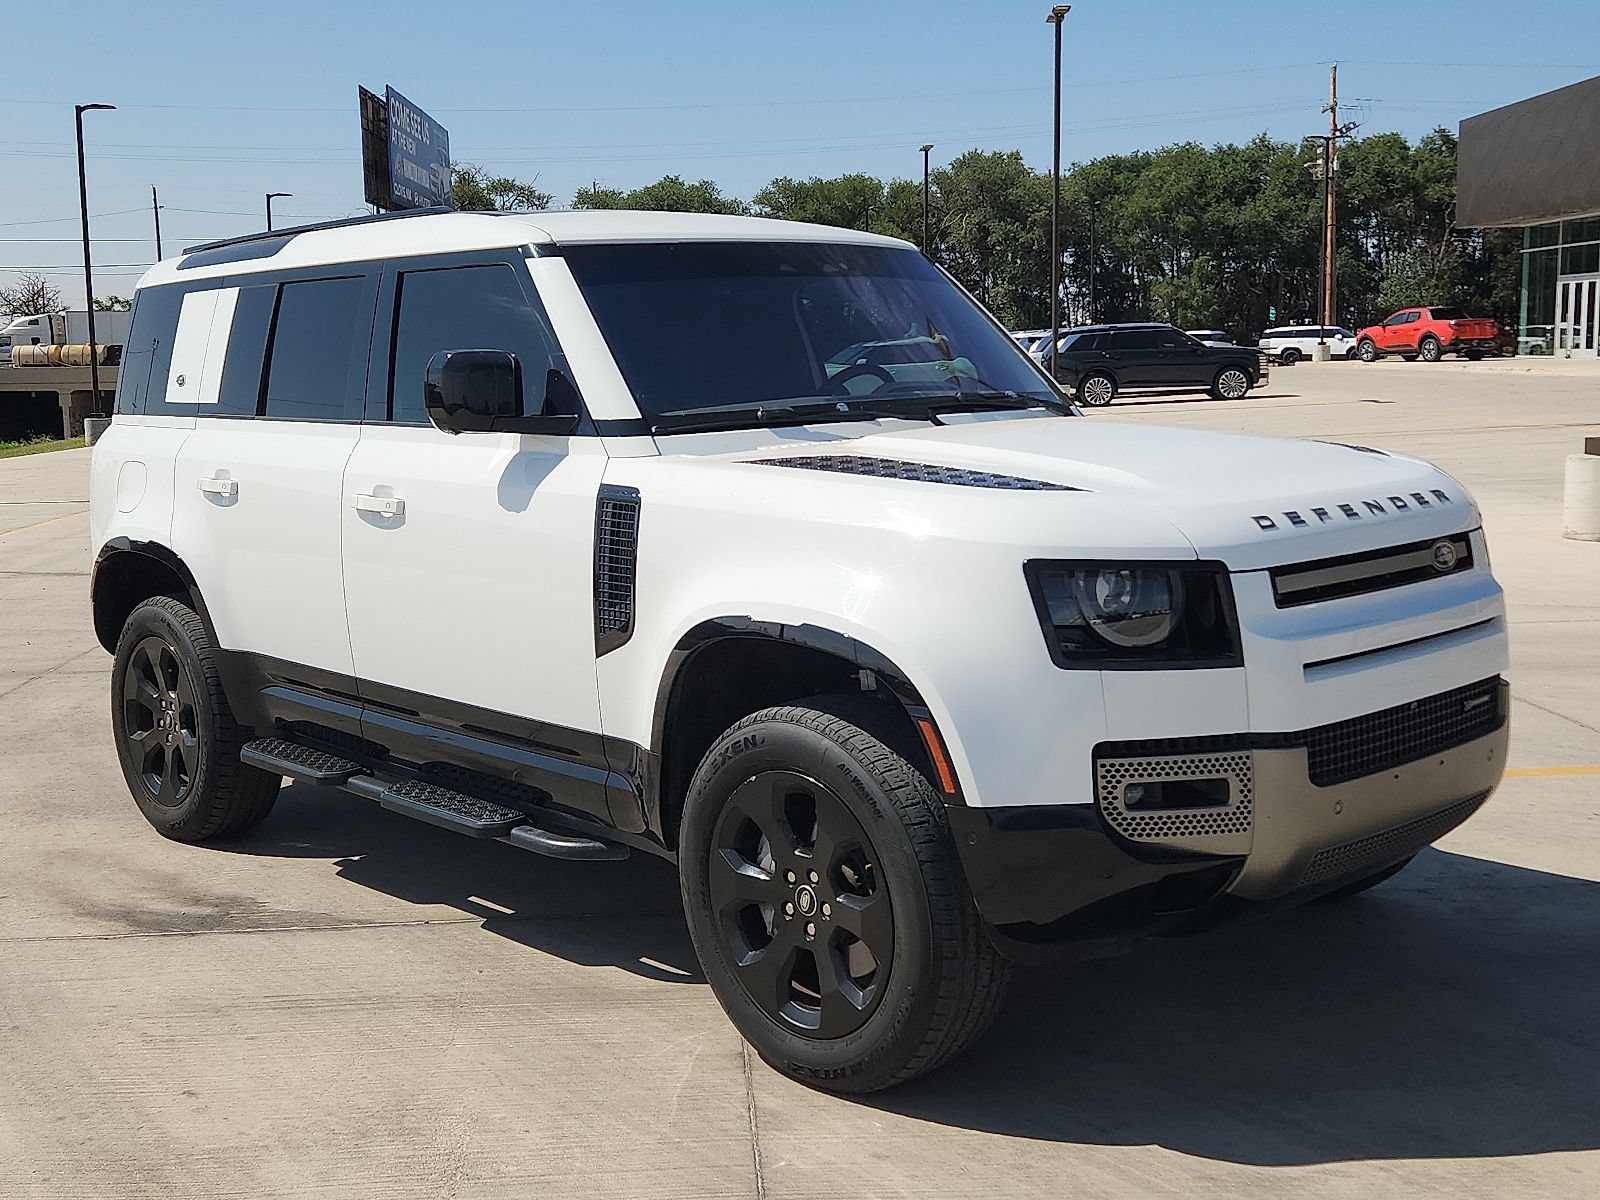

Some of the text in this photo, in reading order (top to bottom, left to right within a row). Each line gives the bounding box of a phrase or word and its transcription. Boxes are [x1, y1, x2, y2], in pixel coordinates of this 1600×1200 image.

[391, 97, 430, 146] COME SEE US
[1251, 489, 1453, 531] DEFENDER
[836, 762, 885, 820] All-Weather
